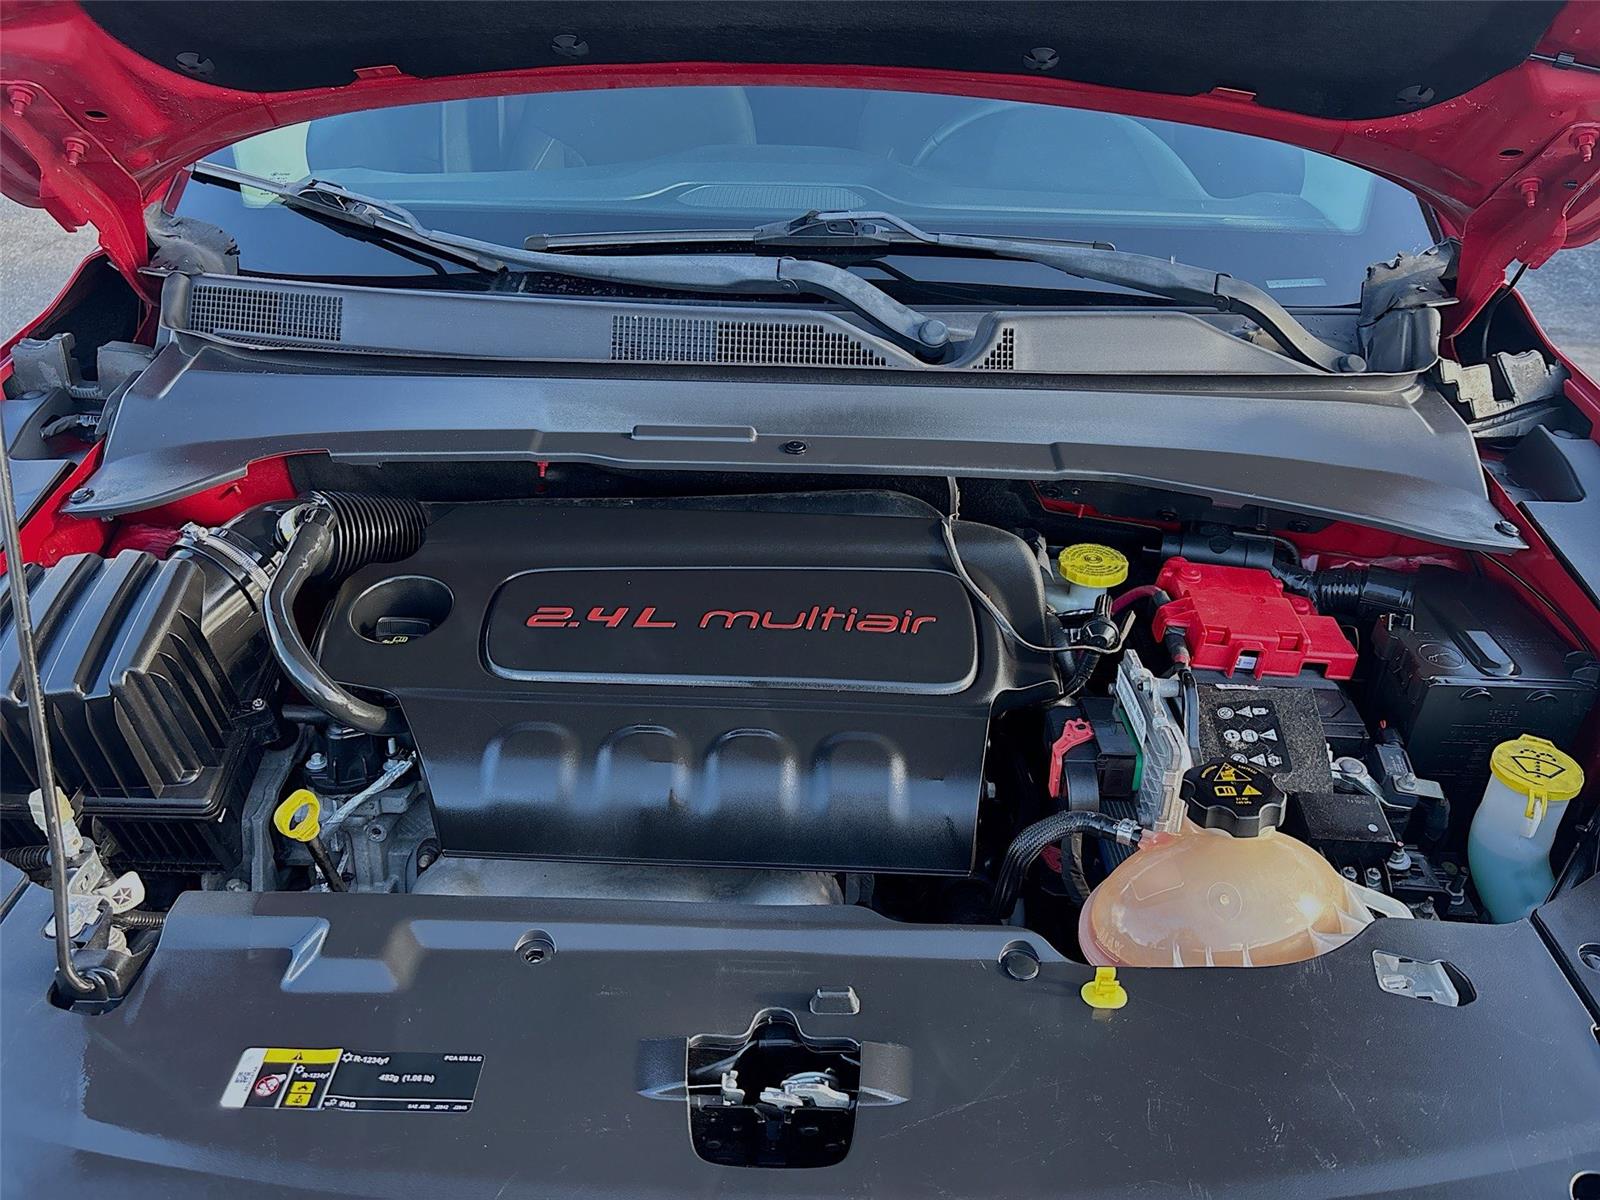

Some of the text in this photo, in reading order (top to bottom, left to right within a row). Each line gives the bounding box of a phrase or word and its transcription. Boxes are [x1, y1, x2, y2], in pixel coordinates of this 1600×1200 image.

[699, 605, 937, 634] multiair
[353, 1055, 390, 1065] R-1234yf
[339, 1100, 356, 1108] PAG
